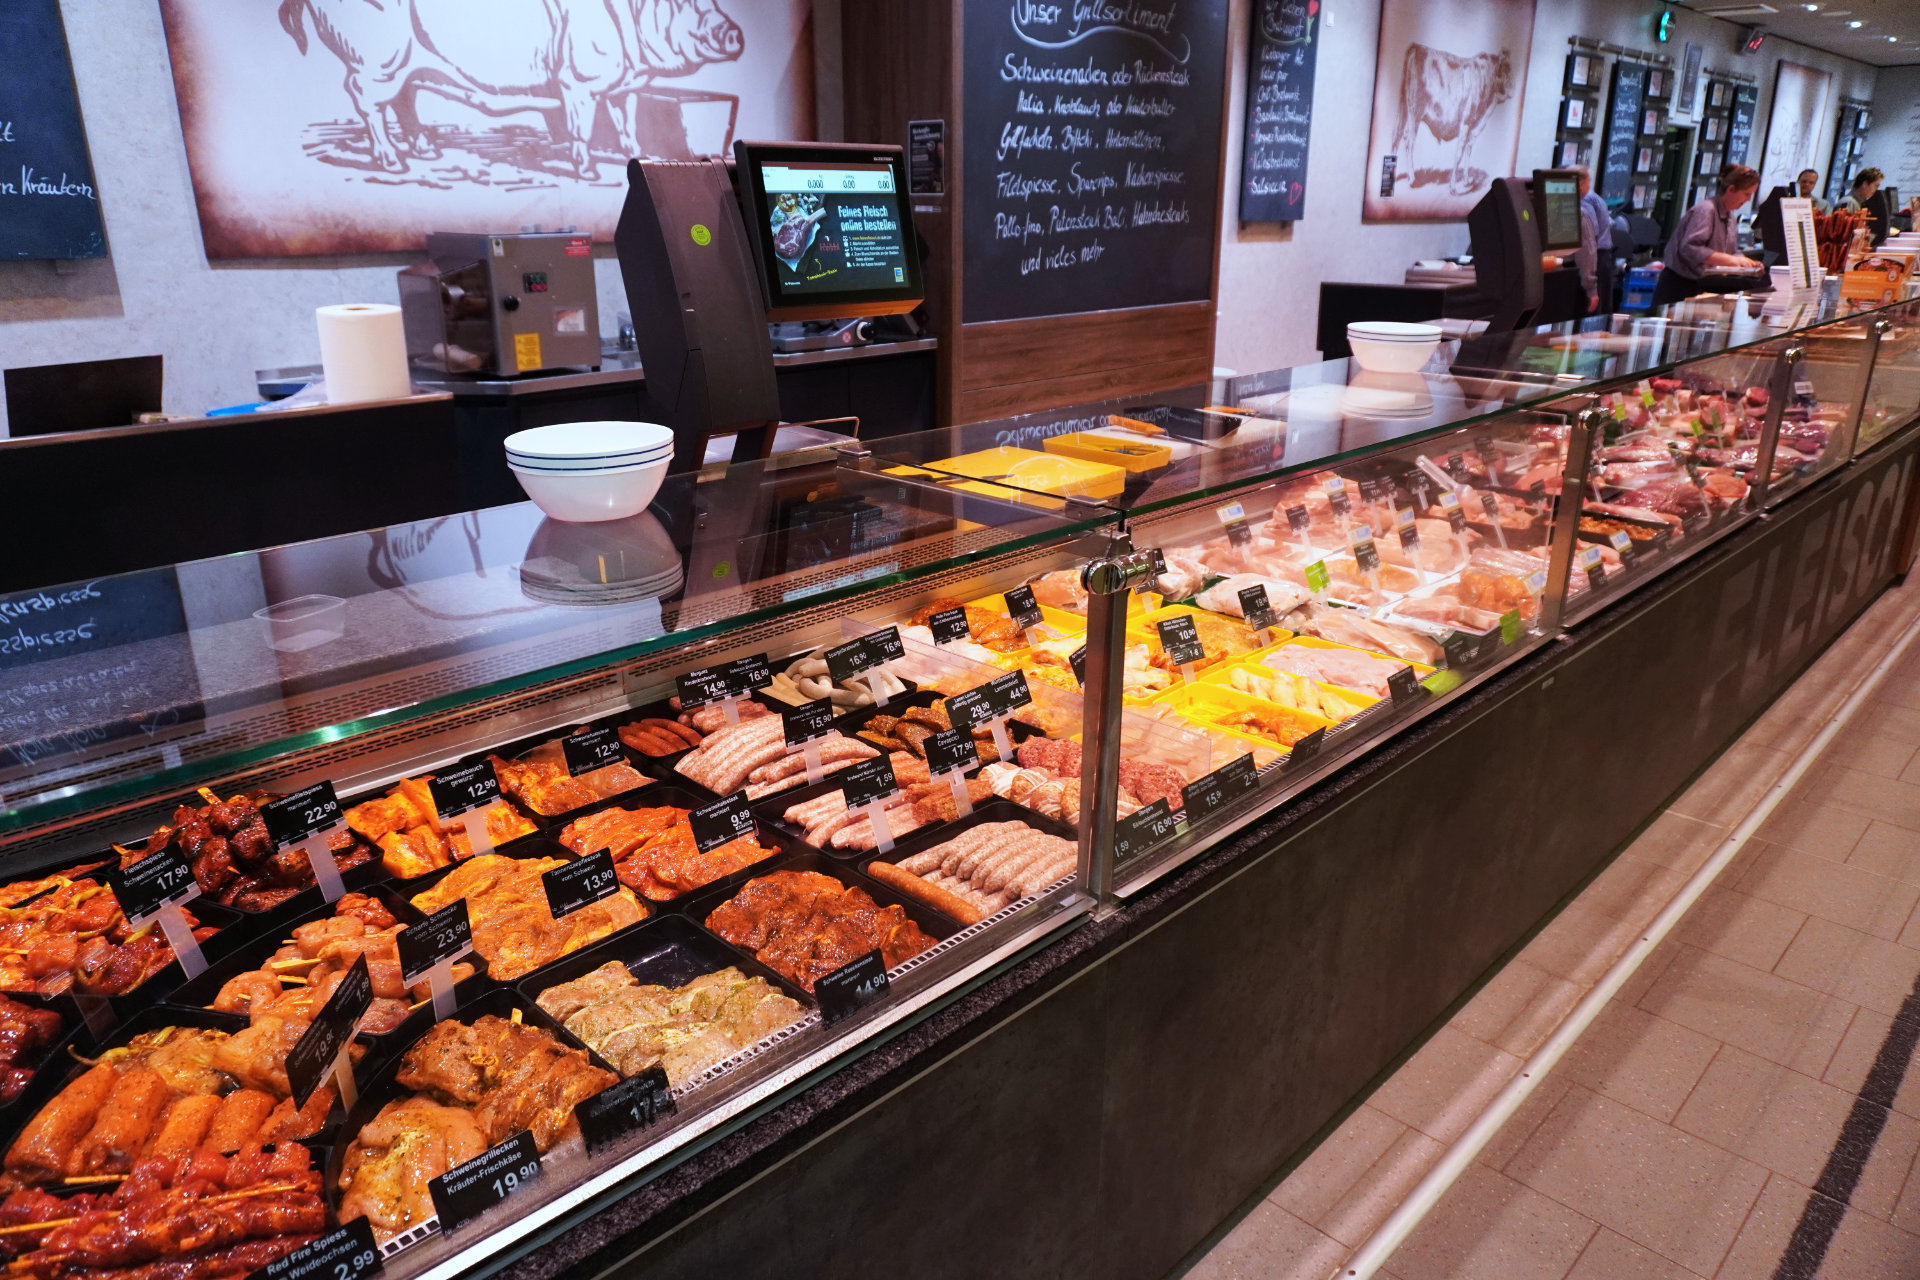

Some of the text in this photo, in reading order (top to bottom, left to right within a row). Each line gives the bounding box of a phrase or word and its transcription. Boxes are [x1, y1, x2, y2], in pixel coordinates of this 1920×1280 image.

[1112, 64, 1132, 86] oder
[837, 204, 889, 218] Feines Fleisch
[840, 218, 897, 232] online bestellen
[1021, 238, 1105, 276] und vieles mehr
[748, 668, 769, 683] 16.90
[703, 680, 726, 695] 14.90
[1010, 684, 1028, 700] 44.90
[809, 713, 832, 729] 15.90
[970, 701, 990, 718] 29.90
[952, 741, 974, 758] 17.90
[436, 764, 484, 785] Schweinebauch
[876, 772, 893, 787] 1.59
[304, 800, 337, 825] 22.90
[730, 809, 751, 828] 9.99
[1152, 817, 1172, 836] 16.90
[123, 851, 166, 876] Fleischspiess
[123, 857, 175, 888] Schweinenacken
[561, 864, 596, 883] vom Schwein
[156, 864, 189, 891] 17.90
[582, 869, 613, 893] 13.90
[414, 916, 453, 941] vom Schwein
[436, 921, 468, 949] 23.90
[356, 977, 370, 1002] 1.99
[441, 1138, 520, 1185] Schweinegrillecken
[446, 1150, 523, 1196] Kräuter-Frischkäse
[266, 1228, 348, 1276] Red Fire Spiess
[288, 1239, 358, 1280] Weideochsen
[333, 1250, 376, 1280] 2.99
